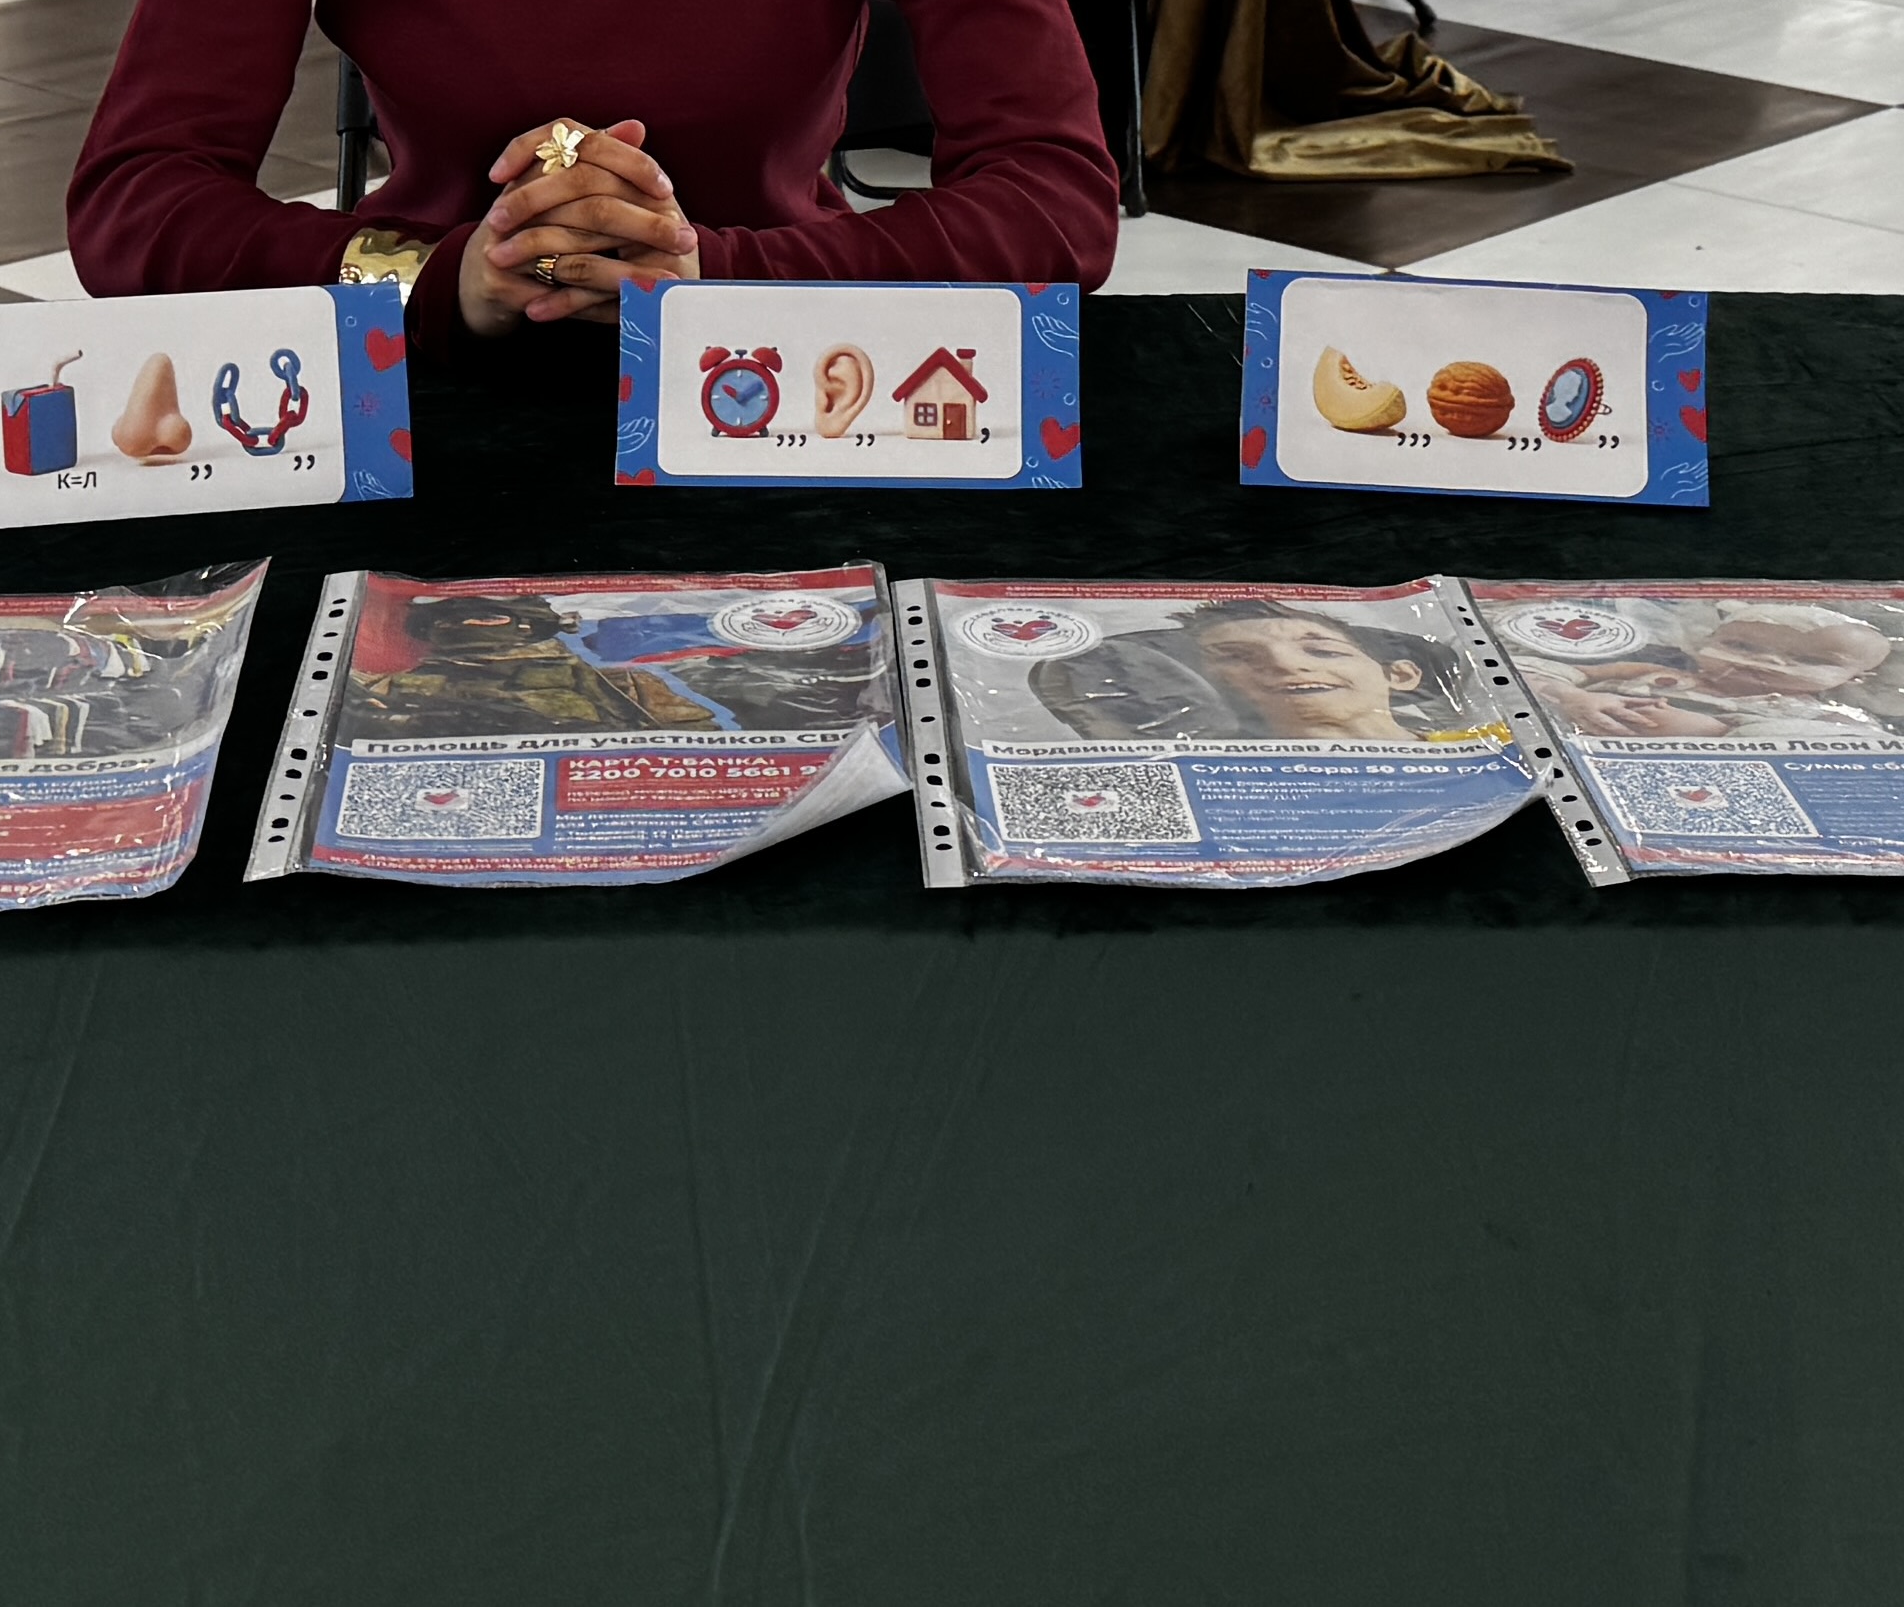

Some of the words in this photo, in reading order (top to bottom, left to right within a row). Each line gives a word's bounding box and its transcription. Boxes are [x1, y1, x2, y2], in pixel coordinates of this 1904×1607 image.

[57, 470, 97, 490] К=Л
[367, 737, 508, 755] Помощь
[516, 736, 580, 752] для
[590, 734, 786, 749] участников
[1174, 741, 1321, 755] Владислав
[1600, 739, 1779, 753] Протасеня
[1787, 739, 1871, 751] Леон
[569, 757, 651, 769] КАРТА
[1191, 763, 1273, 775] Сумма
[1280, 763, 1360, 775] сбора:
[1365, 764, 1398, 774] 50
[1401, 764, 1450, 774] 000
[1456, 760, 1507, 777] руб.
[569, 768, 641, 781] 2200
[649, 767, 718, 779] 7010
